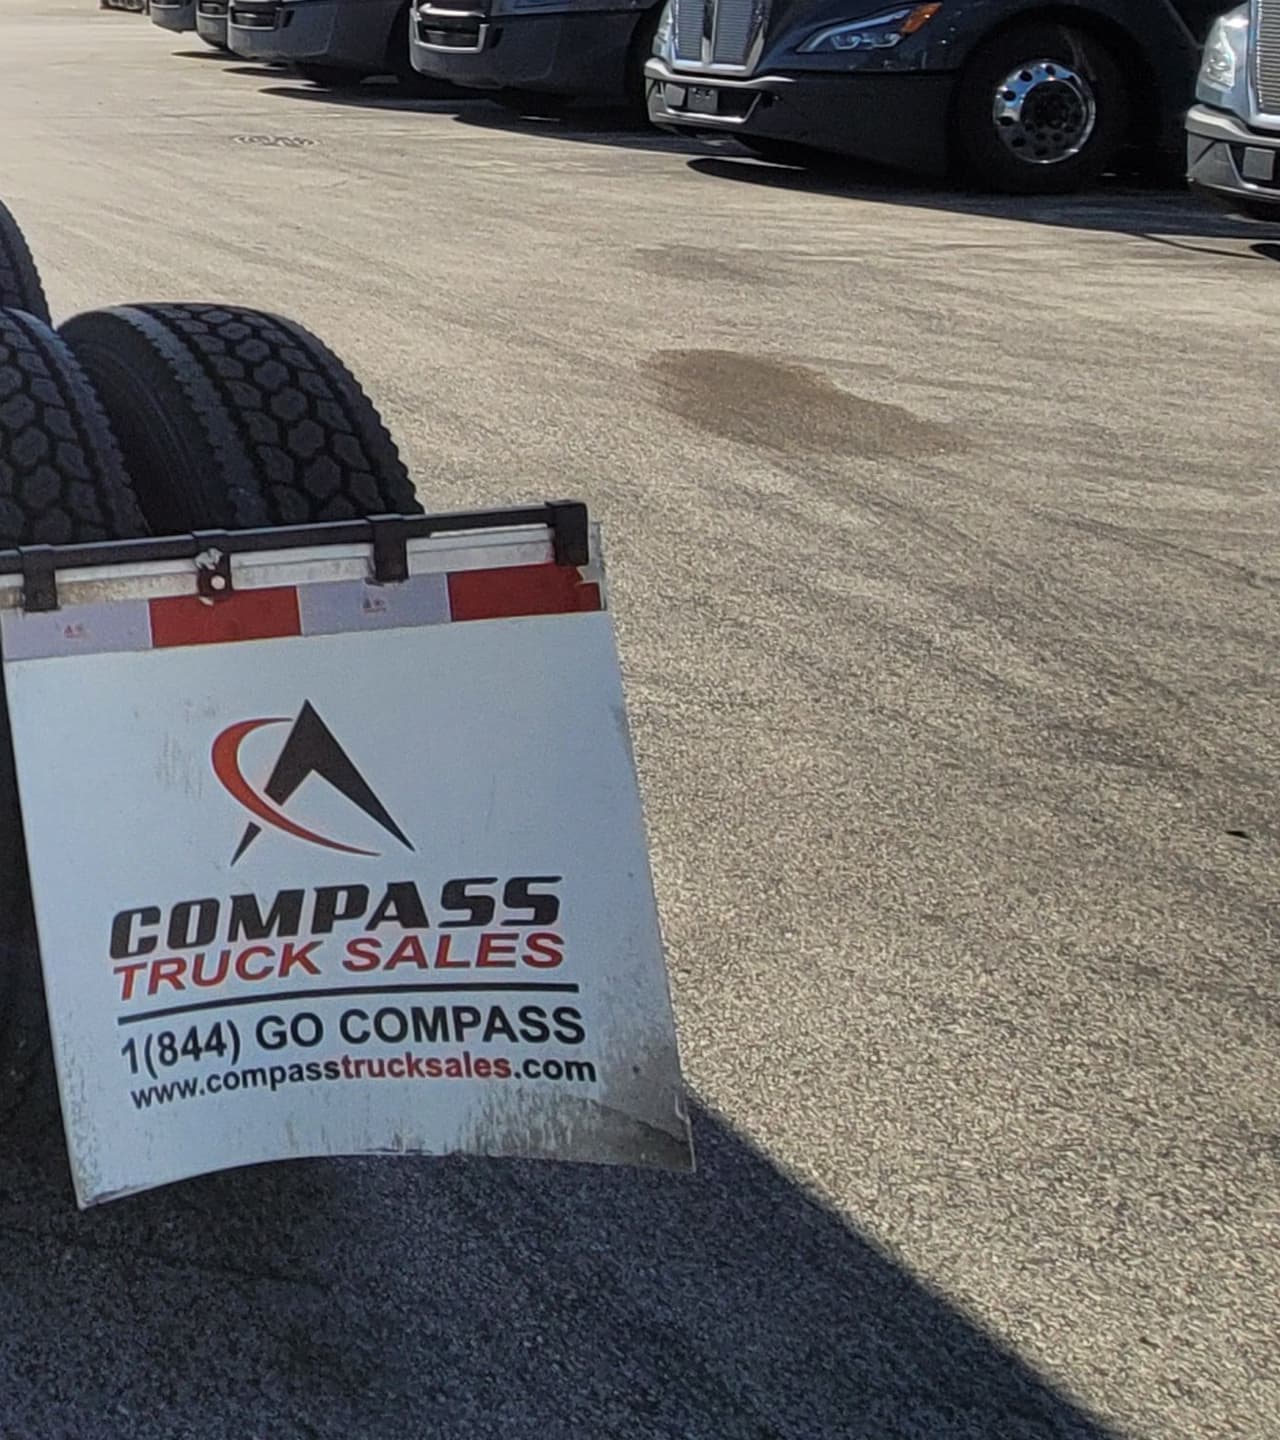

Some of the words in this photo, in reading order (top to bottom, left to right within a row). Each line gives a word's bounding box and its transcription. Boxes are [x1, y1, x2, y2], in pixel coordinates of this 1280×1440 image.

[109, 875, 563, 960] COMPASS
[112, 940, 324, 1002] TRUCK
[342, 932, 565, 973] SALES
[121, 1019, 241, 1080] 1(844)
[255, 1012, 324, 1050] GO
[339, 1005, 586, 1044] COMPASS
[130, 1051, 597, 1110] www.compasstrucksales.com
